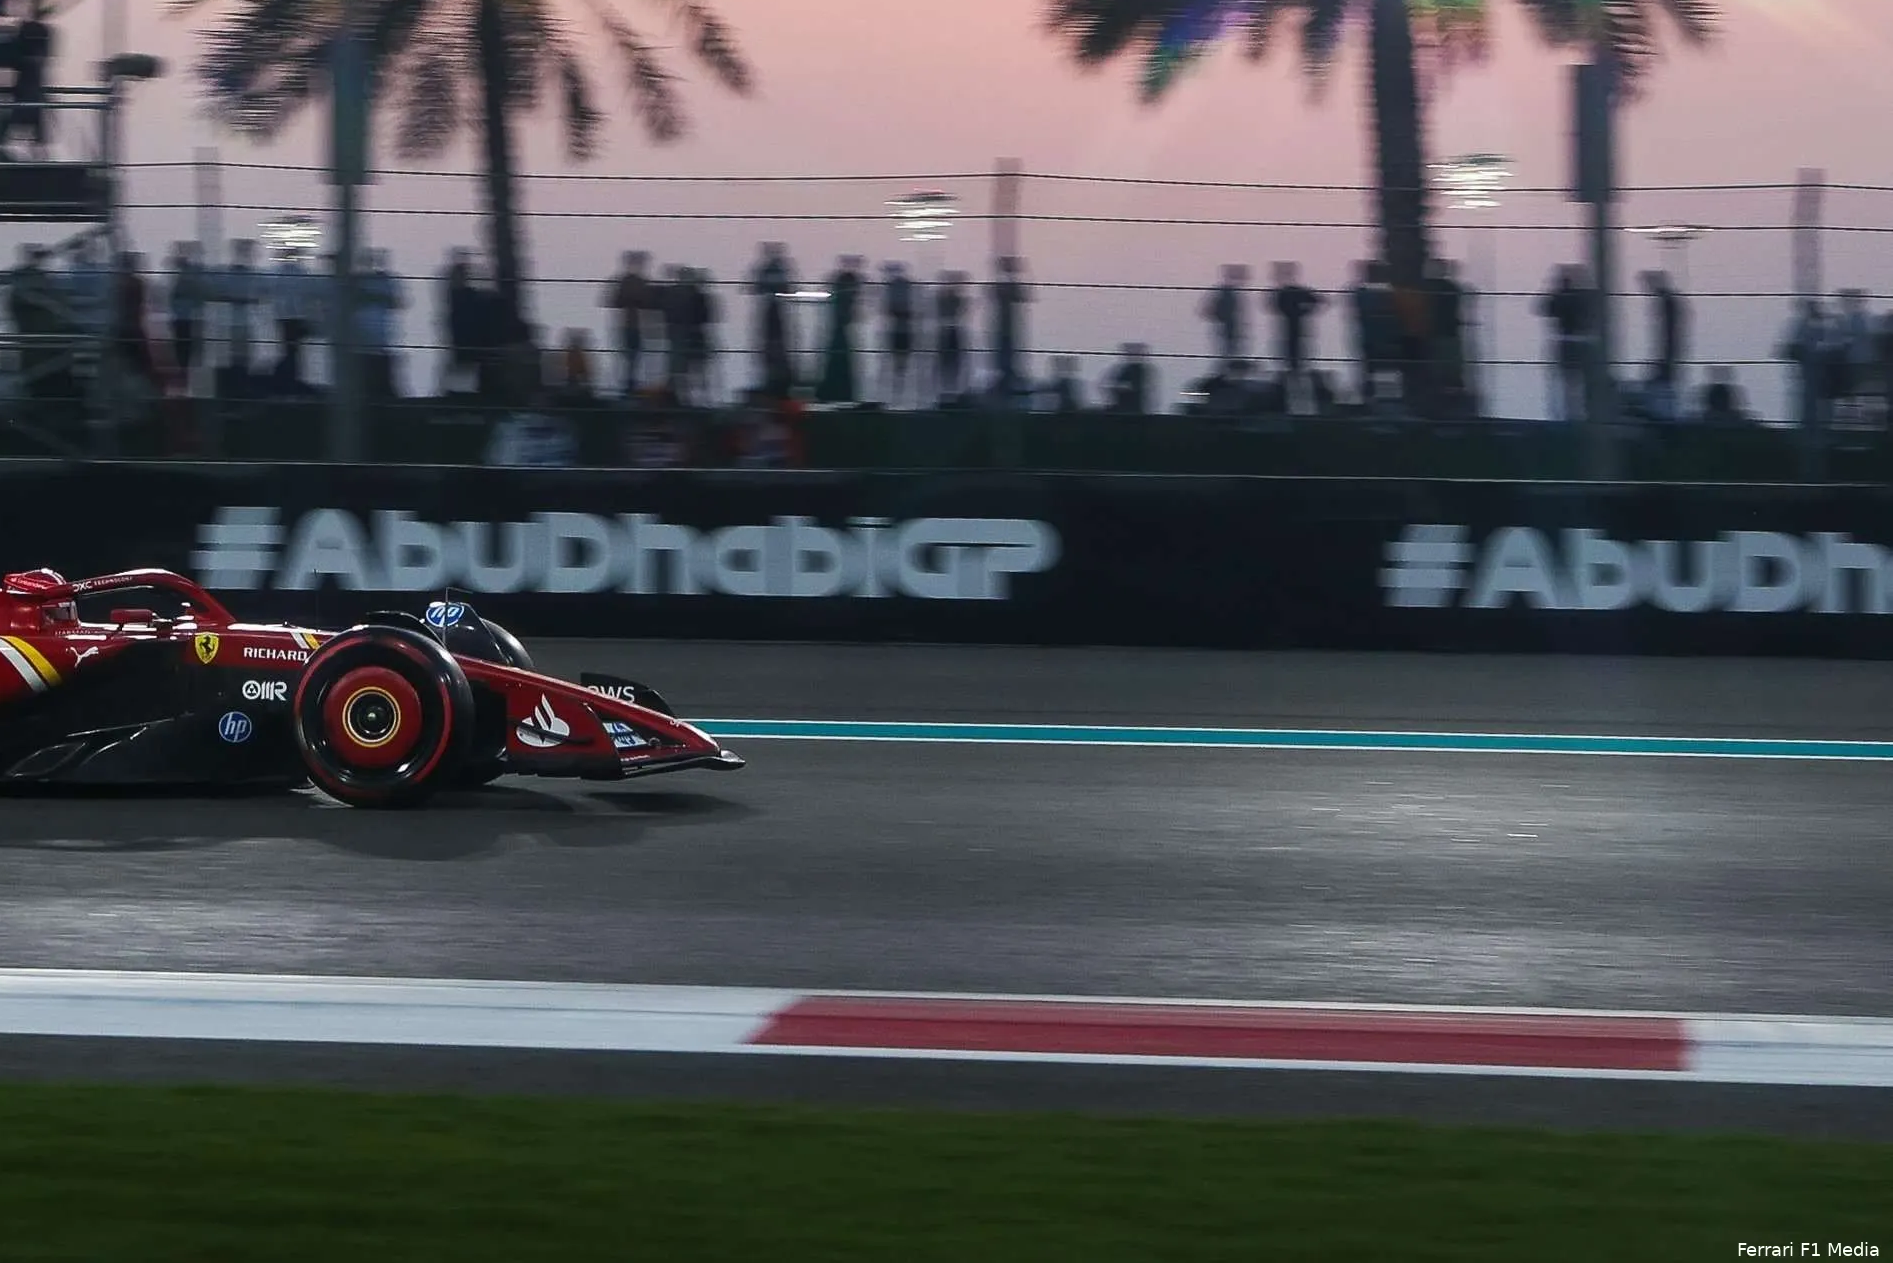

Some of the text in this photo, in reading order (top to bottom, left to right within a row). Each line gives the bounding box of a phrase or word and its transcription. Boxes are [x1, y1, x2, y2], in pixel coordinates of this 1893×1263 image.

[188, 506, 1063, 600] #AbuDhabiGP
[243, 646, 308, 662] RICHARD
[224, 712, 248, 743] hp
